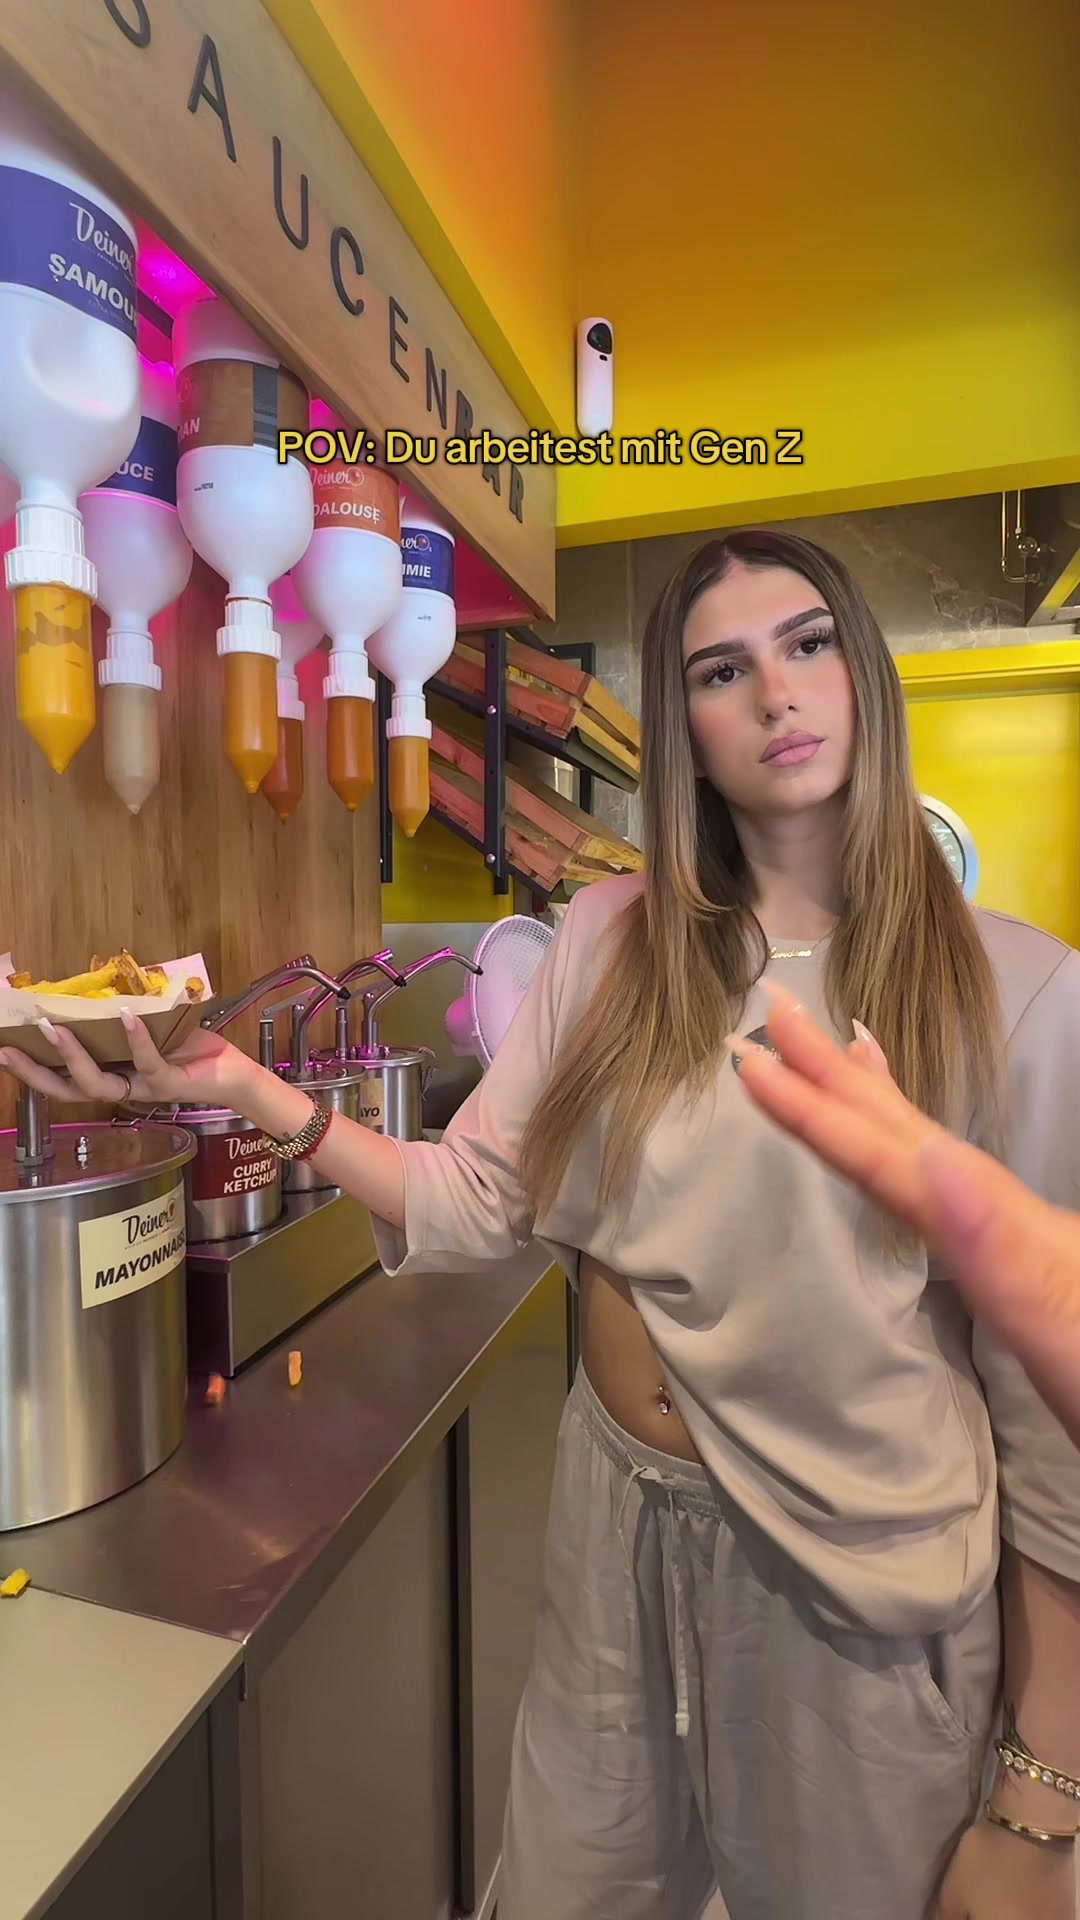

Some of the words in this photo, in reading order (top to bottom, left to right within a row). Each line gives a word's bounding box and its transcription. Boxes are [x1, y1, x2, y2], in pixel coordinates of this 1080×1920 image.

[48, 253, 138, 328] SAMOU
[224, 1137, 270, 1160] Deine
[223, 1168, 277, 1194] KETCHUP
[233, 1158, 272, 1179] CURRY
[94, 1228, 185, 1290] MAYONNAIS
